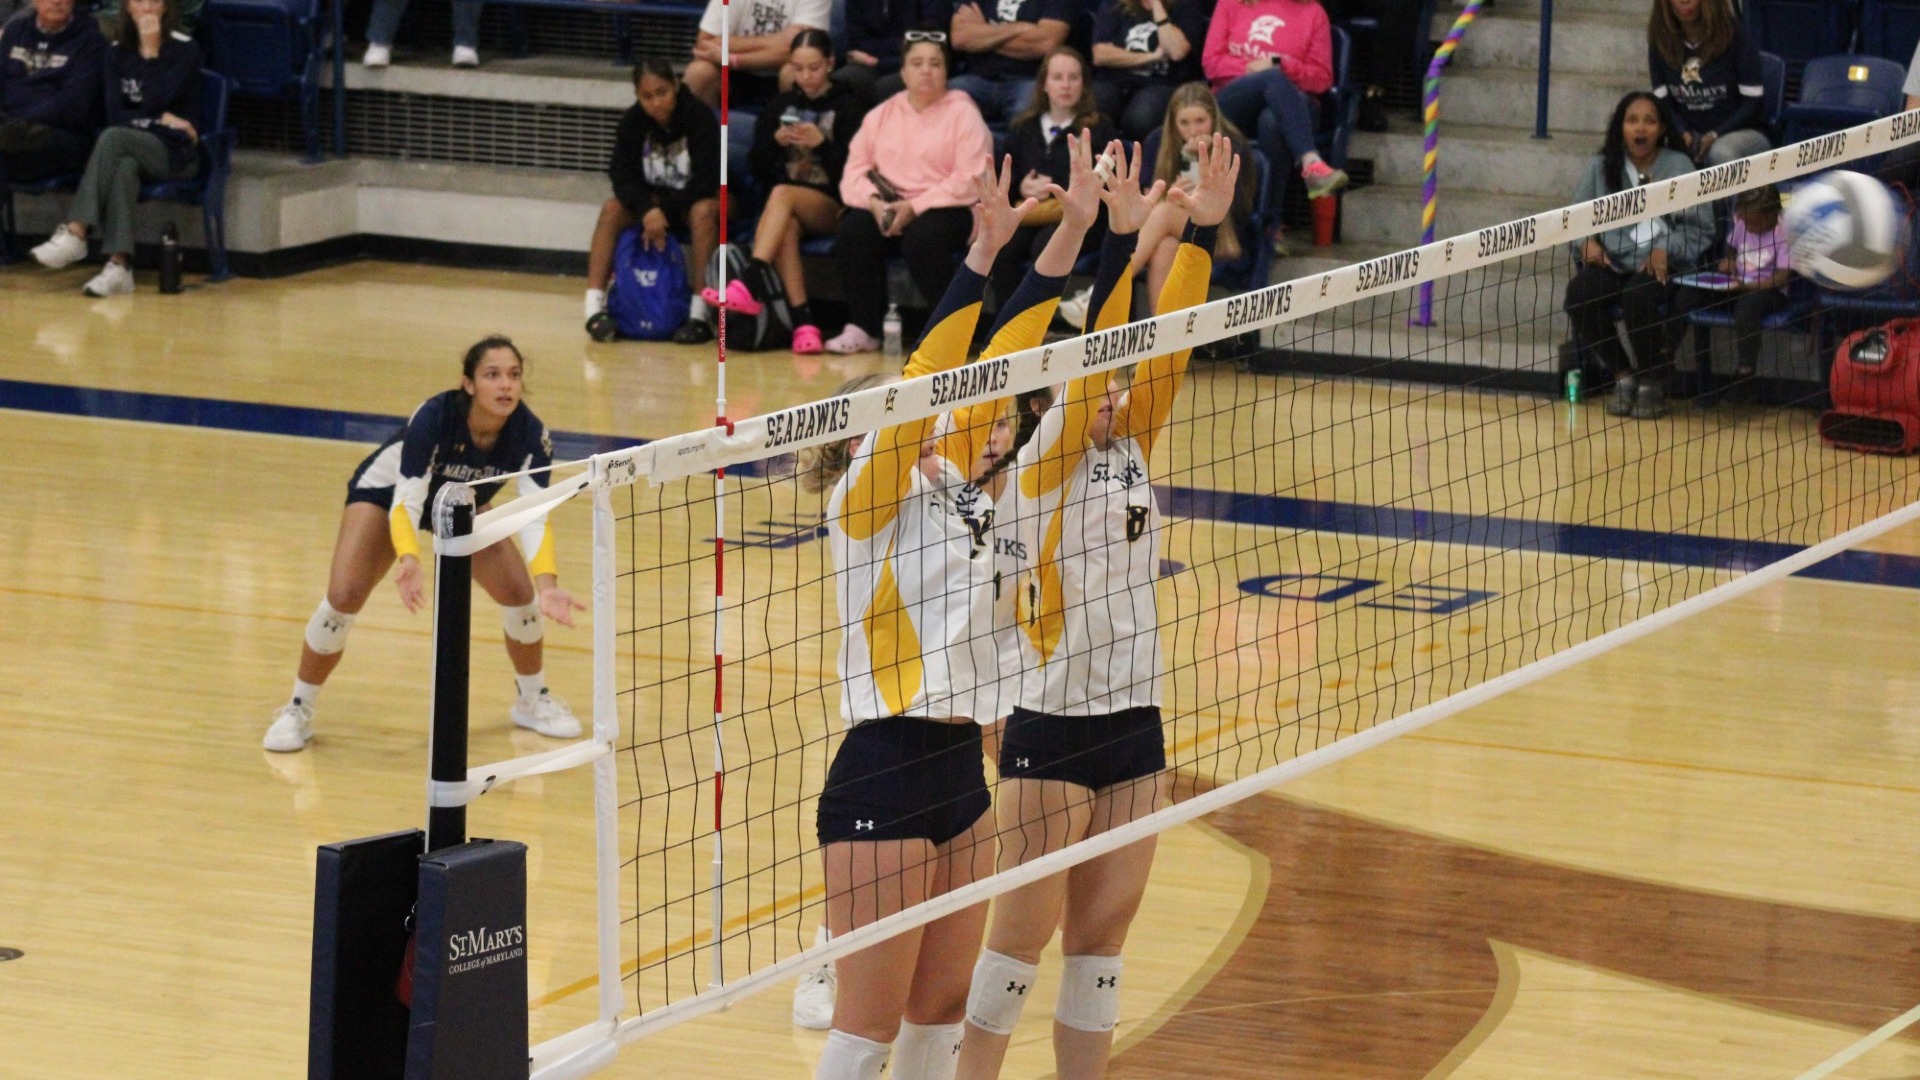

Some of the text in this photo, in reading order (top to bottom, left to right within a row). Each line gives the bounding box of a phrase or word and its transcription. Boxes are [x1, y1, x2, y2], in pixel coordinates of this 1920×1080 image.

[1796, 132, 1847, 168] SEAHAWKS
[1700, 159, 1751, 197] SEAHAWKS
[1591, 188, 1646, 226] SEAHAWKS
[1478, 217, 1536, 258] SEAHAWKS
[1356, 250, 1420, 293] SEAHAWKS
[1224, 284, 1293, 329] SEAHAWKS
[1083, 321, 1157, 368] SEAHAWKS
[930, 358, 1010, 407] SEAHAWKS
[765, 397, 850, 448] SEAHAWKS
[449, 958, 481, 975] COLLEGE
[486, 948, 523, 965] MARYLAND
[467, 925, 523, 957] MARY'S
